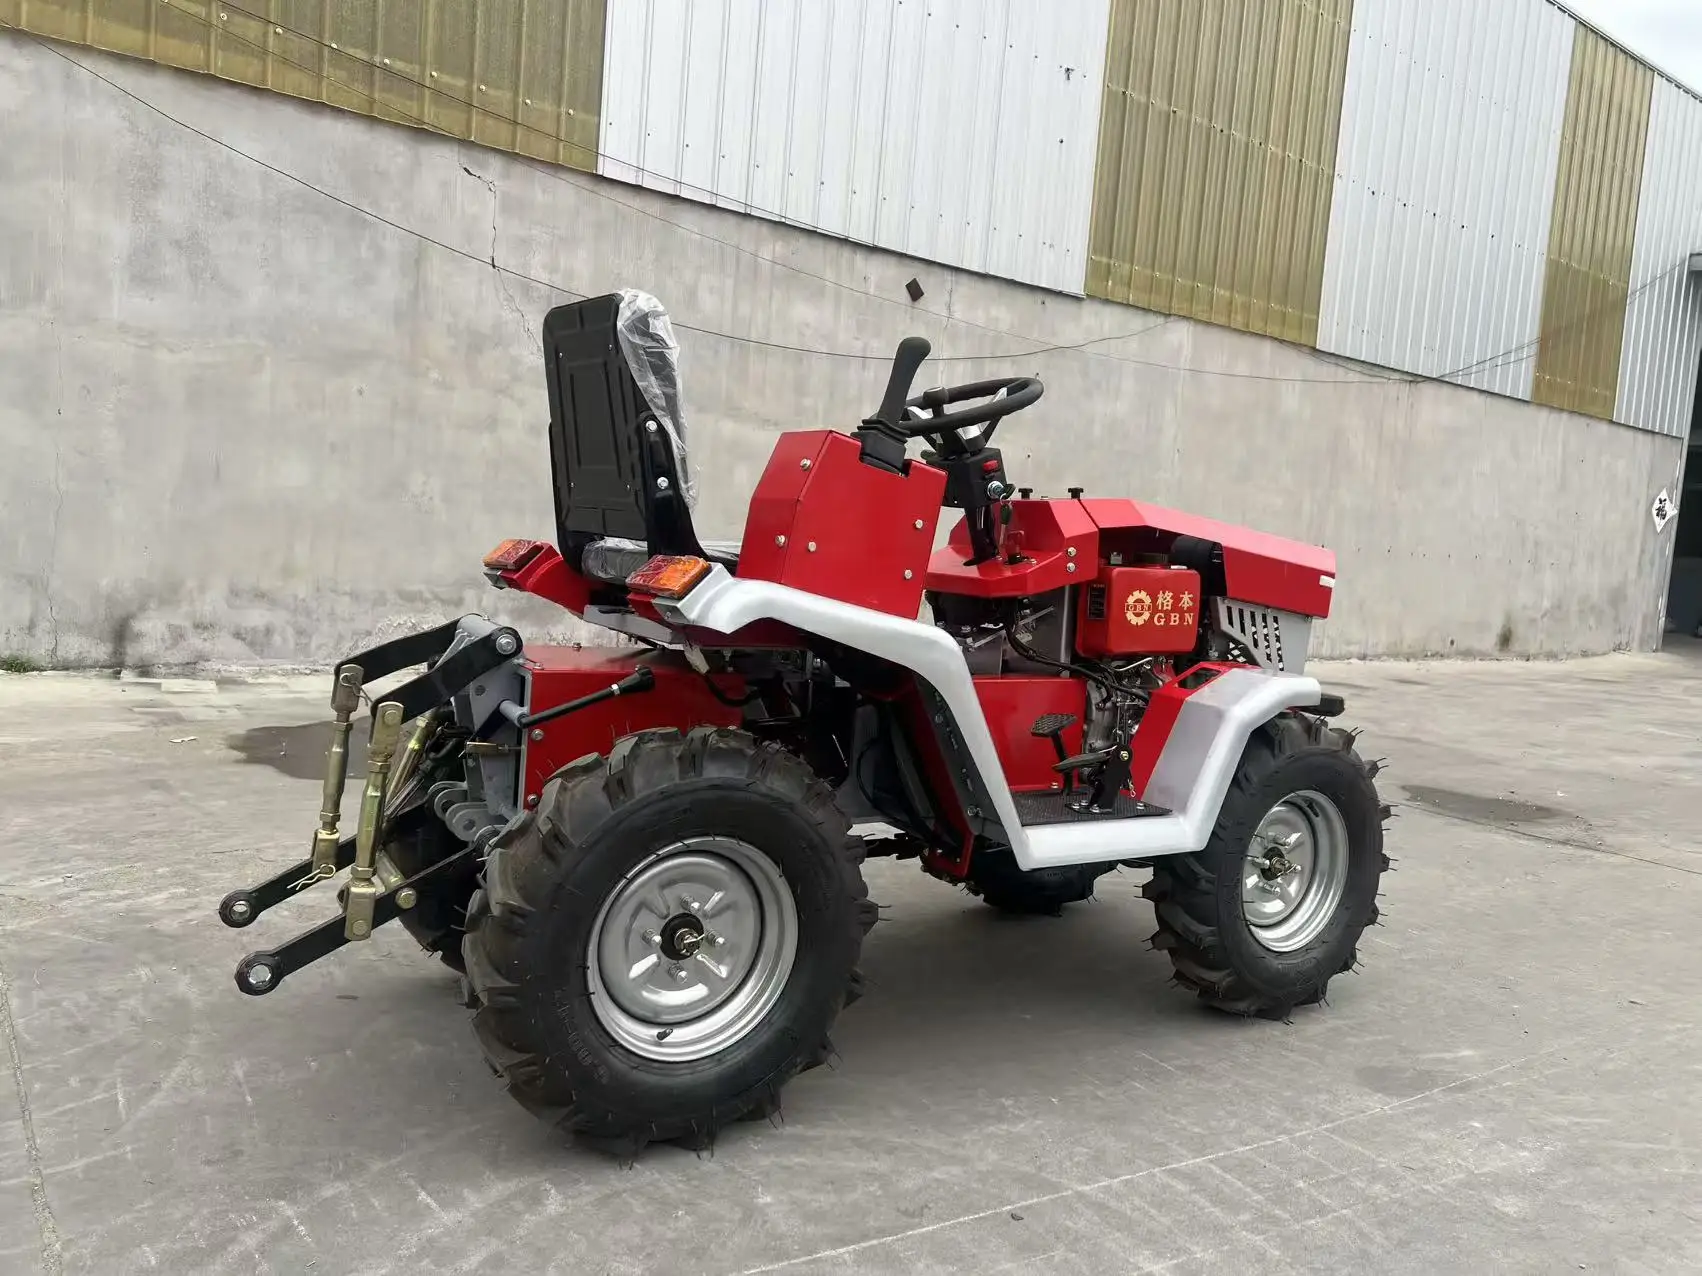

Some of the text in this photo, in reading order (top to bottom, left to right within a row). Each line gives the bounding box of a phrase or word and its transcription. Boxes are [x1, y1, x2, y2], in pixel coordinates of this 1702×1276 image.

[1128, 603, 1149, 611] GBN
[1156, 590, 1194, 611] 格本
[1153, 612, 1194, 626] GBN
